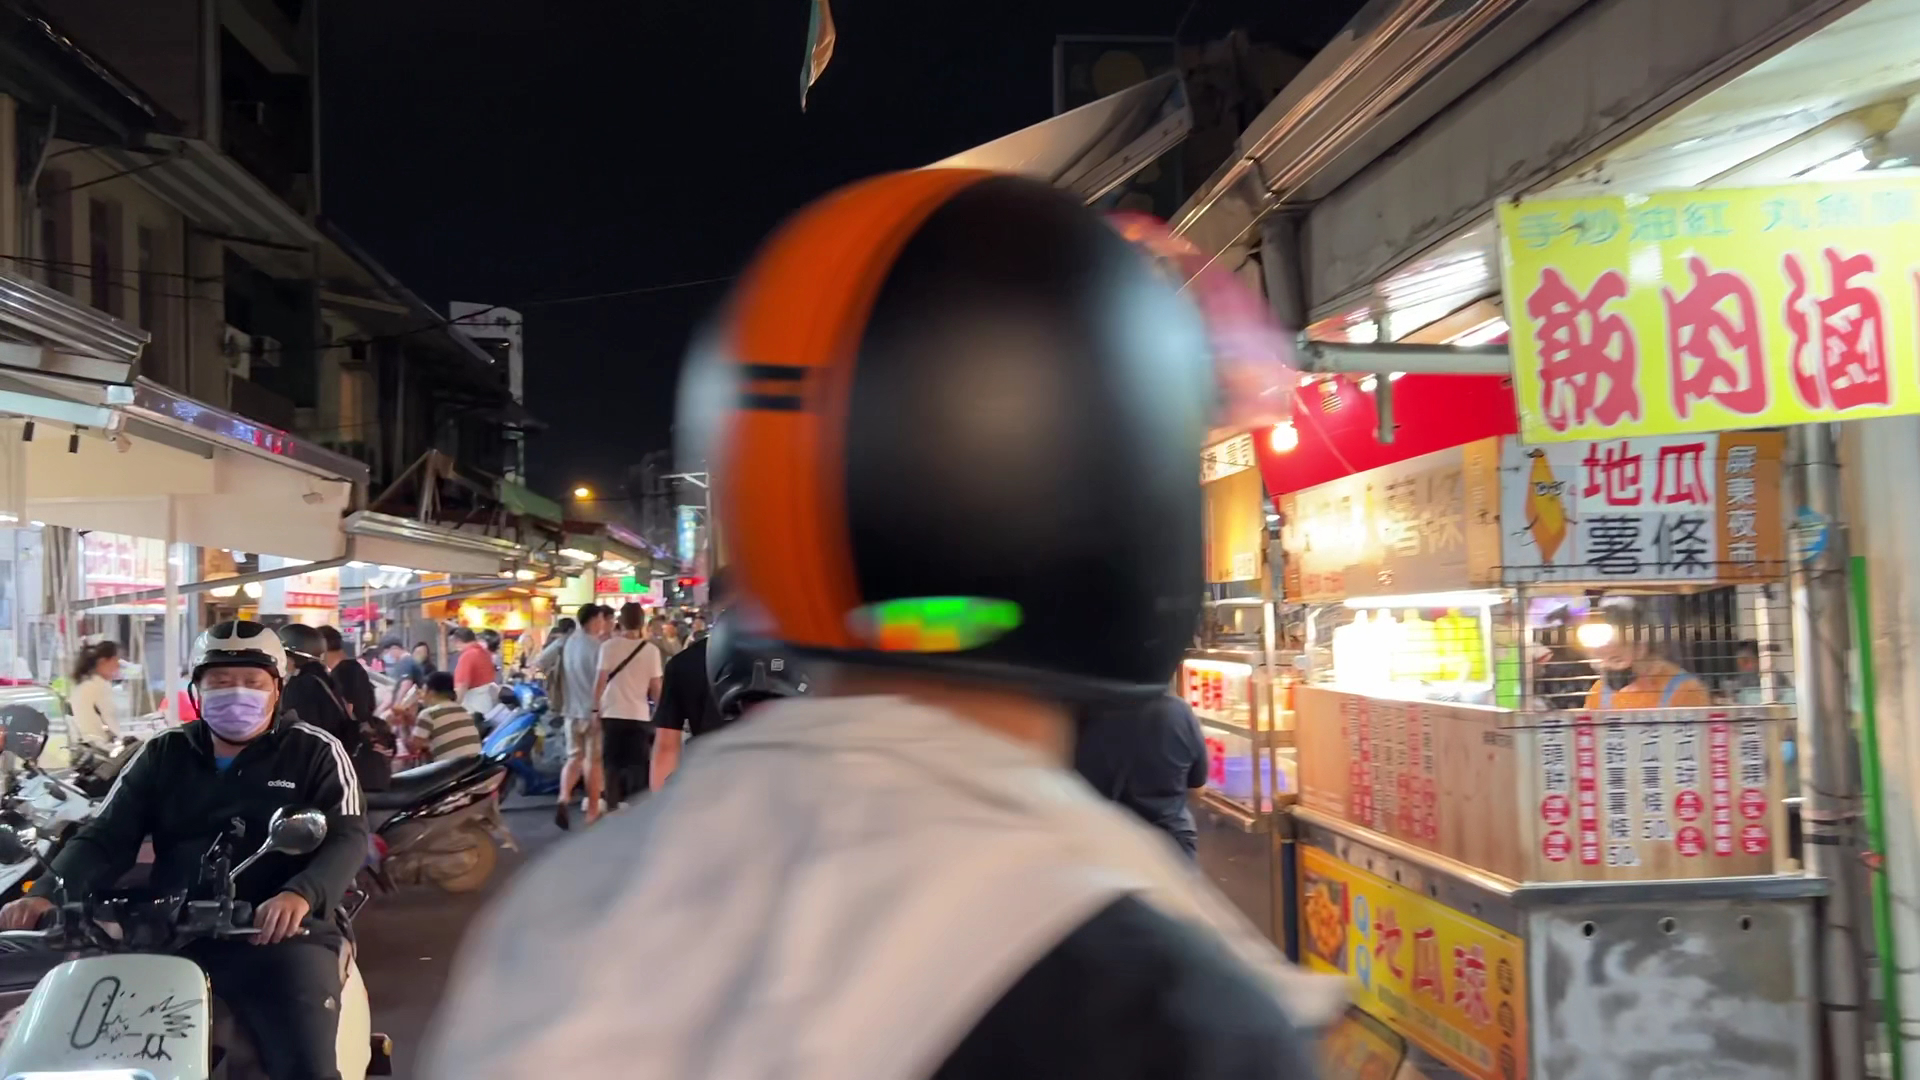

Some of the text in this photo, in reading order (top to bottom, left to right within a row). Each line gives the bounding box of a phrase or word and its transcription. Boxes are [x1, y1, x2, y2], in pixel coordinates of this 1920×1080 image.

[1582, 440, 1709, 507] 地瓜
[1725, 444, 1758, 569] 屏東夜市
[1583, 513, 1710, 577] 薯條
[267, 779, 296, 789] adidas
